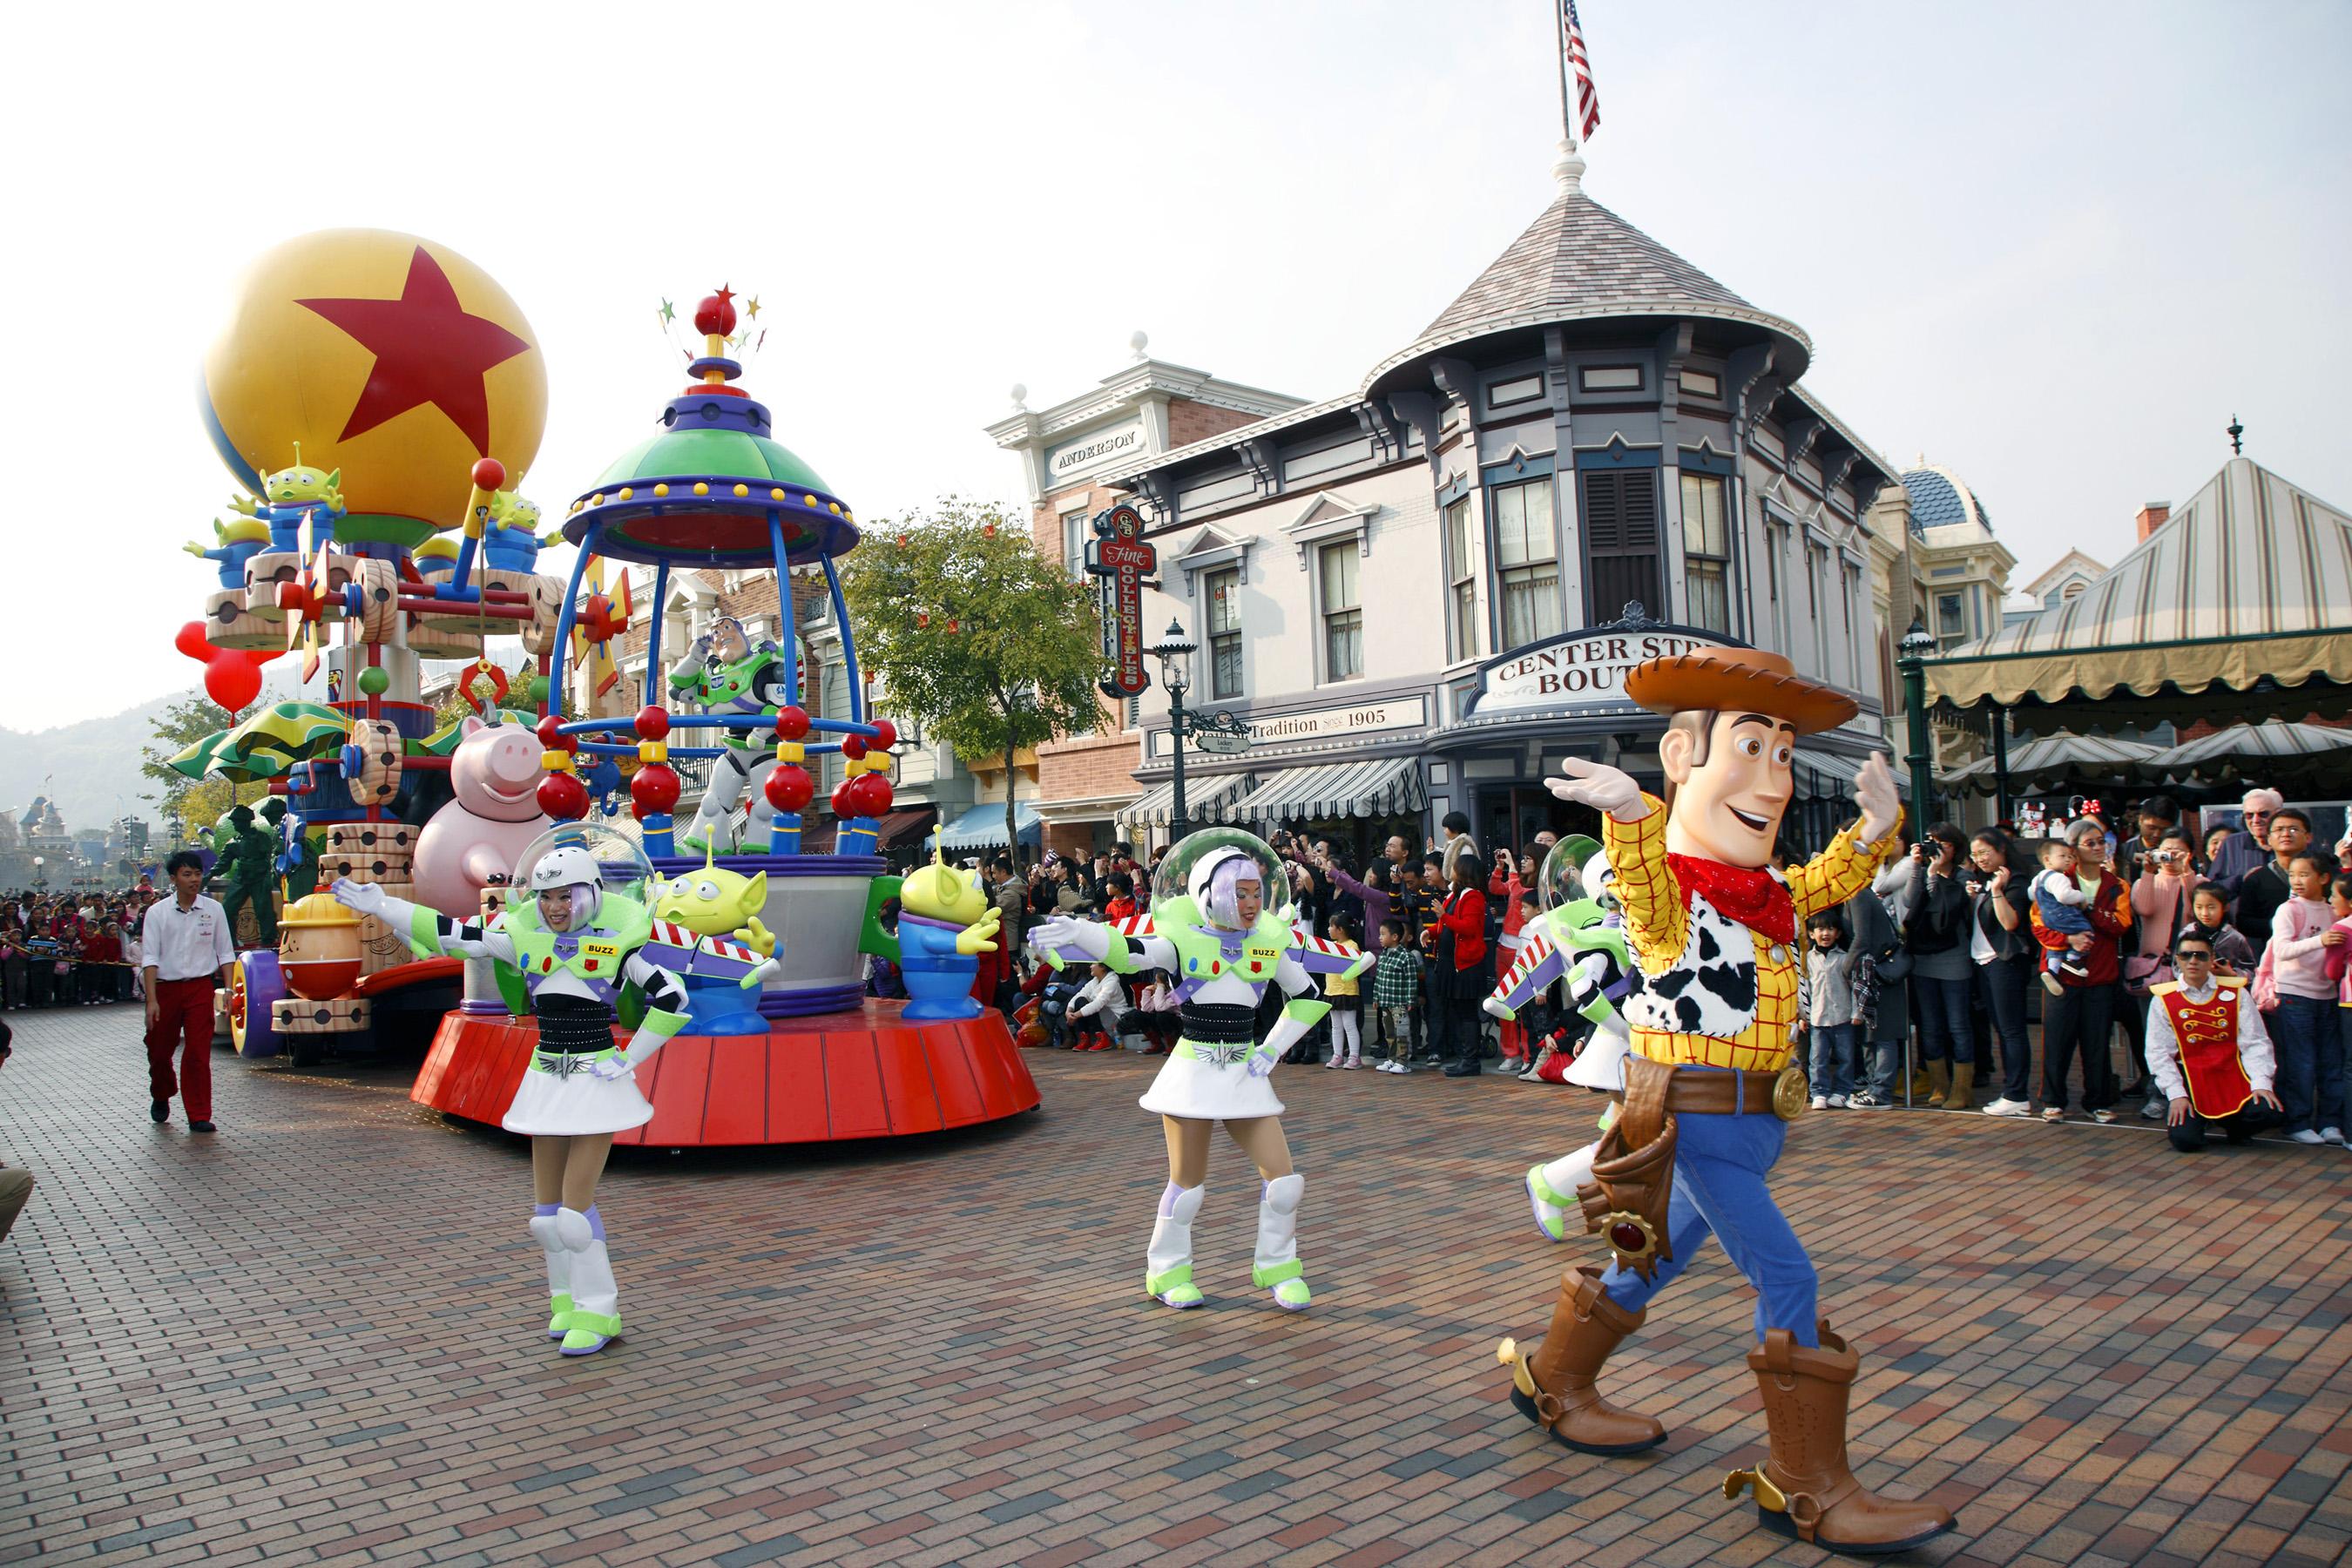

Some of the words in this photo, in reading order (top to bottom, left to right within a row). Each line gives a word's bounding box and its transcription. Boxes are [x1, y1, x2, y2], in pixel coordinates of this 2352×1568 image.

[1058, 431, 1135, 469] ANDERSON
[1106, 546, 1149, 566] Fine
[1121, 564, 1138, 686] COLLECTBLES
[1498, 638, 1630, 681] CENTER
[1641, 637, 1715, 659] STR
[1251, 719, 1318, 739] Tradition
[1348, 709, 1386, 727] 1905
[588, 945, 613, 955] BUZZ
